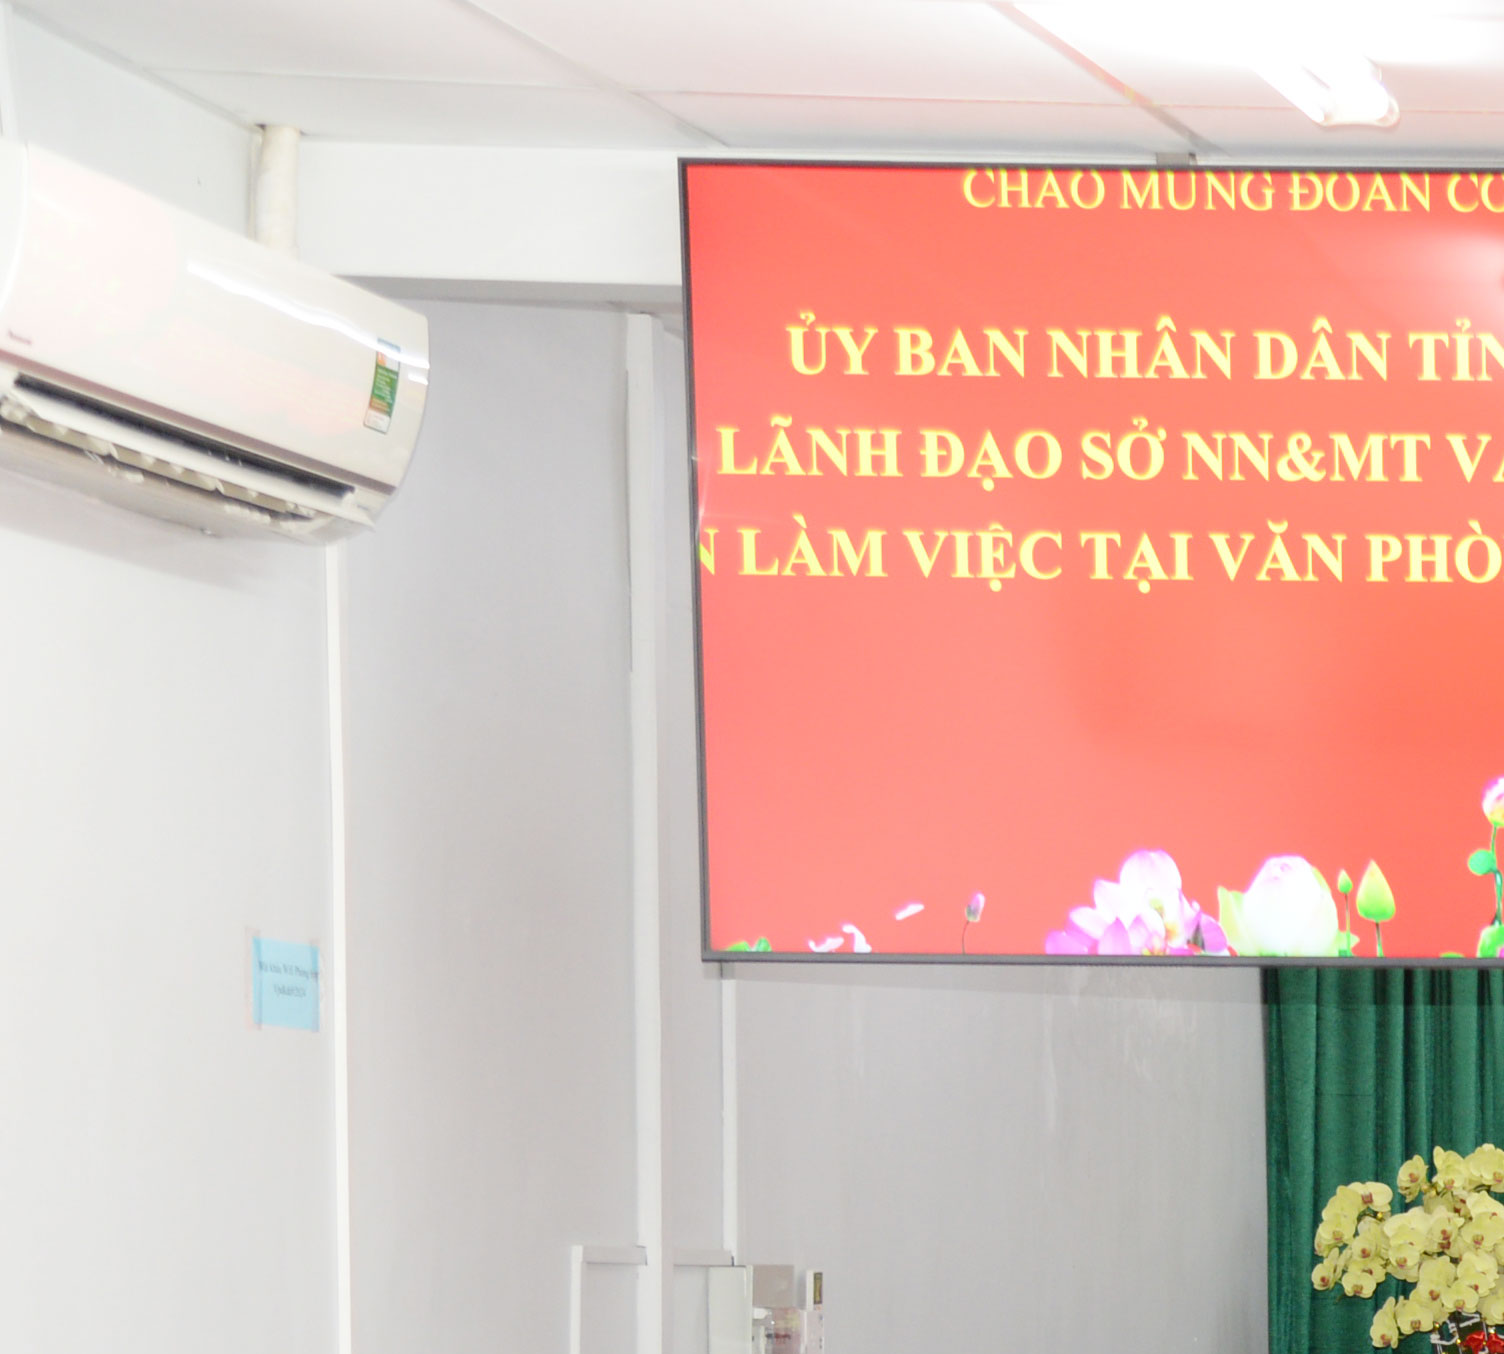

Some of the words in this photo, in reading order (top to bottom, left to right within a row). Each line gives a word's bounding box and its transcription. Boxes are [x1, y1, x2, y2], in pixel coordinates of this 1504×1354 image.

[785, 310, 879, 376] ỦY
[893, 326, 1029, 378] BAN
[1046, 314, 1236, 380] NHÂN
[1252, 316, 1391, 382] DÂN
[716, 413, 904, 478] LÃNH
[919, 428, 1063, 493] ĐẠO
[1080, 419, 1169, 481] SỞ
[1181, 431, 1431, 483] NN&MT
[737, 512, 888, 578] LÀM
[903, 520, 1063, 593] VIỆC
[1079, 528, 1194, 595] TẠI
[1208, 519, 1348, 584] VĂN
